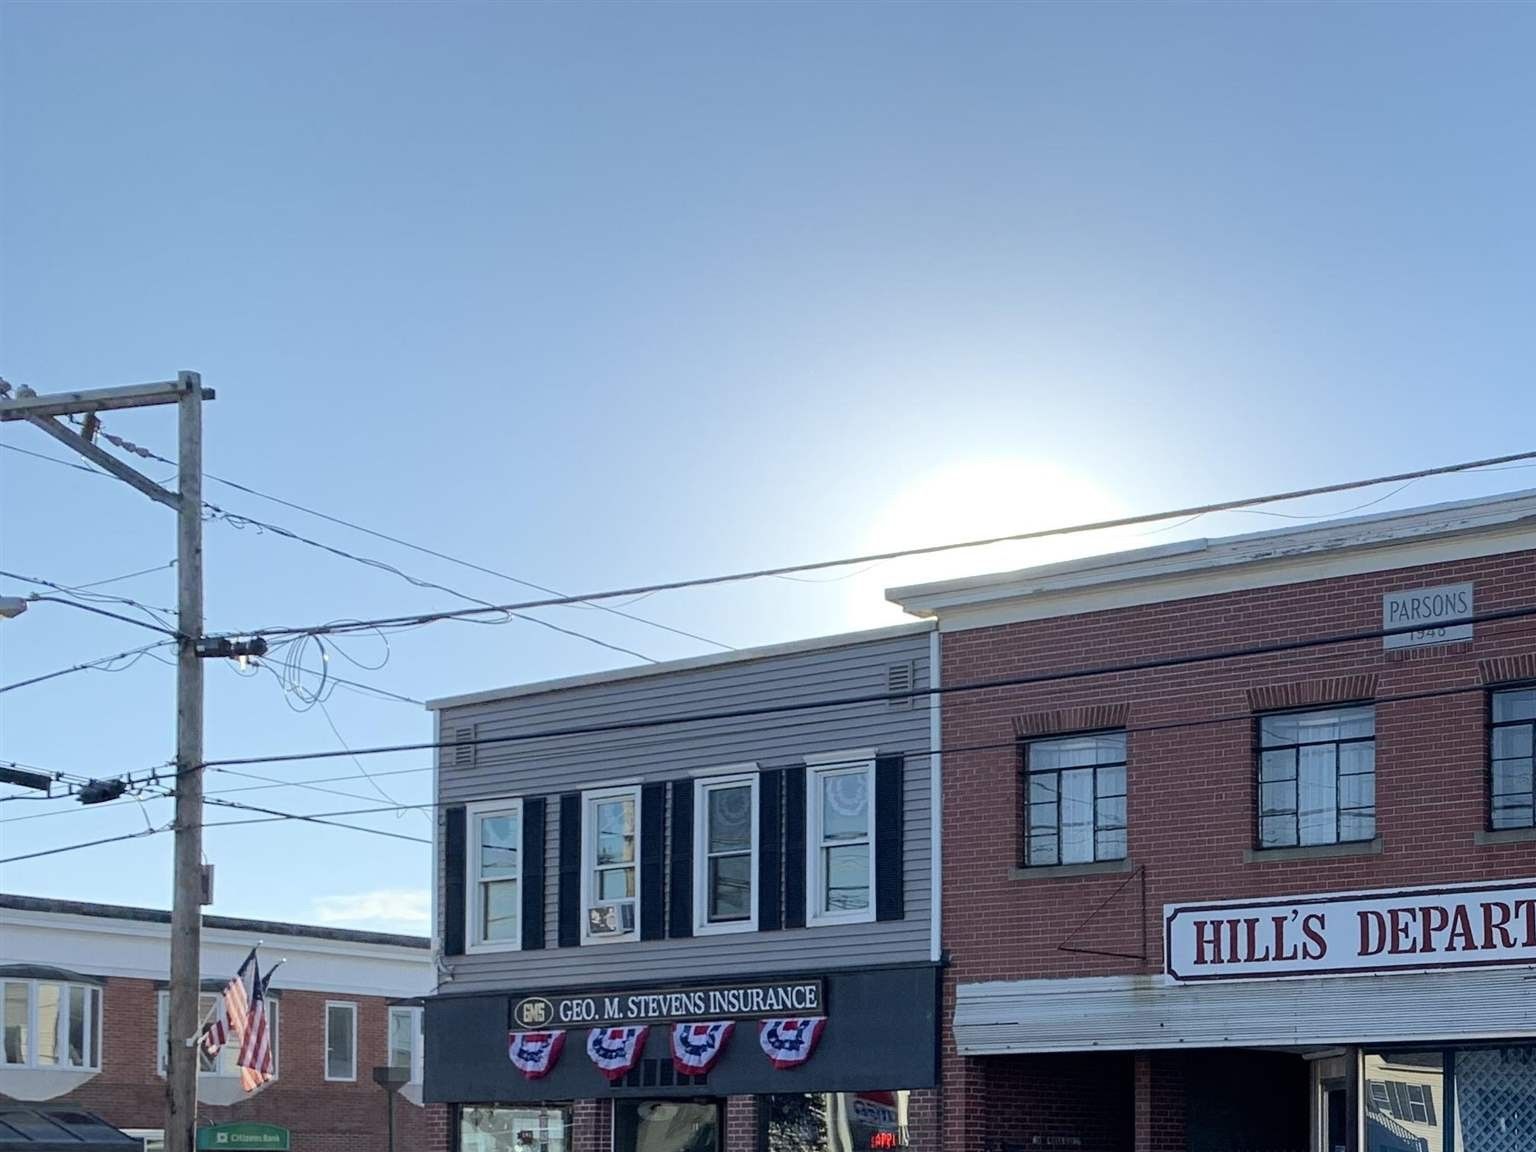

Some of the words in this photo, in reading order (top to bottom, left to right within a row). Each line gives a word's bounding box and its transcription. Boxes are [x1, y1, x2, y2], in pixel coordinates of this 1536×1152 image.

[1389, 591, 1468, 622] PARSONS
[1193, 909, 1328, 965] HILL'S
[523, 1003, 545, 1022] GMS
[559, 998, 599, 1021] GEO.
[604, 997, 624, 1019] M.
[627, 992, 705, 1018] STEVENS
[709, 986, 818, 1013] INSURANCE
